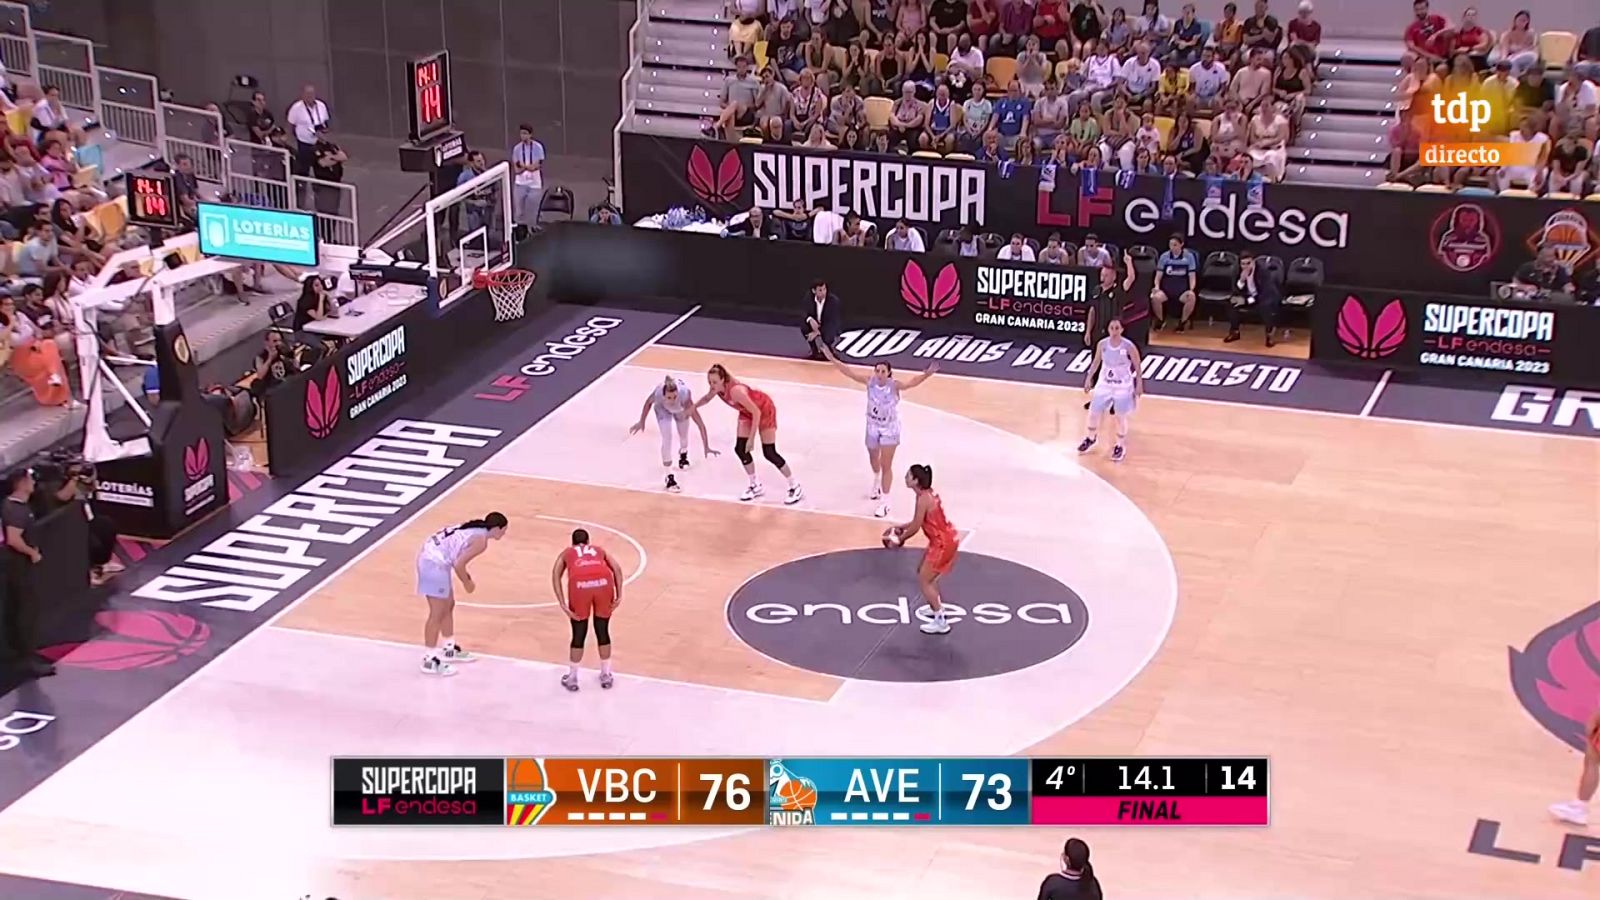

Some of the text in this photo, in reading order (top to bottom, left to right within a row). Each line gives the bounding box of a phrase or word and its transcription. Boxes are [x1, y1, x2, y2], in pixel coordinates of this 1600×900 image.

[424, 84, 442, 123] 14
[753, 152, 986, 227] SUPERCOPA
[1036, 186, 1349, 248] LF endesa
[977, 266, 1087, 302] SUPERCOPA
[975, 312, 1086, 333] GRAN CANARIA 2023
[988, 297, 1073, 316] LF endesa
[1424, 303, 1555, 341] SUPERCOPA
[347, 325, 406, 386] SUPERCOPA
[473, 317, 624, 401] LF endesa
[835, 328, 1302, 393] 100 AÑOS DE BONCESTO
[1420, 352, 1551, 374] GRAN CANARIA 2023
[1438, 336, 1537, 356] LF endesa
[349, 400, 368, 419] GRAN
[1490, 384, 1600, 430] GR
[130, 418, 503, 612] SUPERCOPA
[574, 545, 598, 558] 14
[746, 596, 1072, 625] endesa
